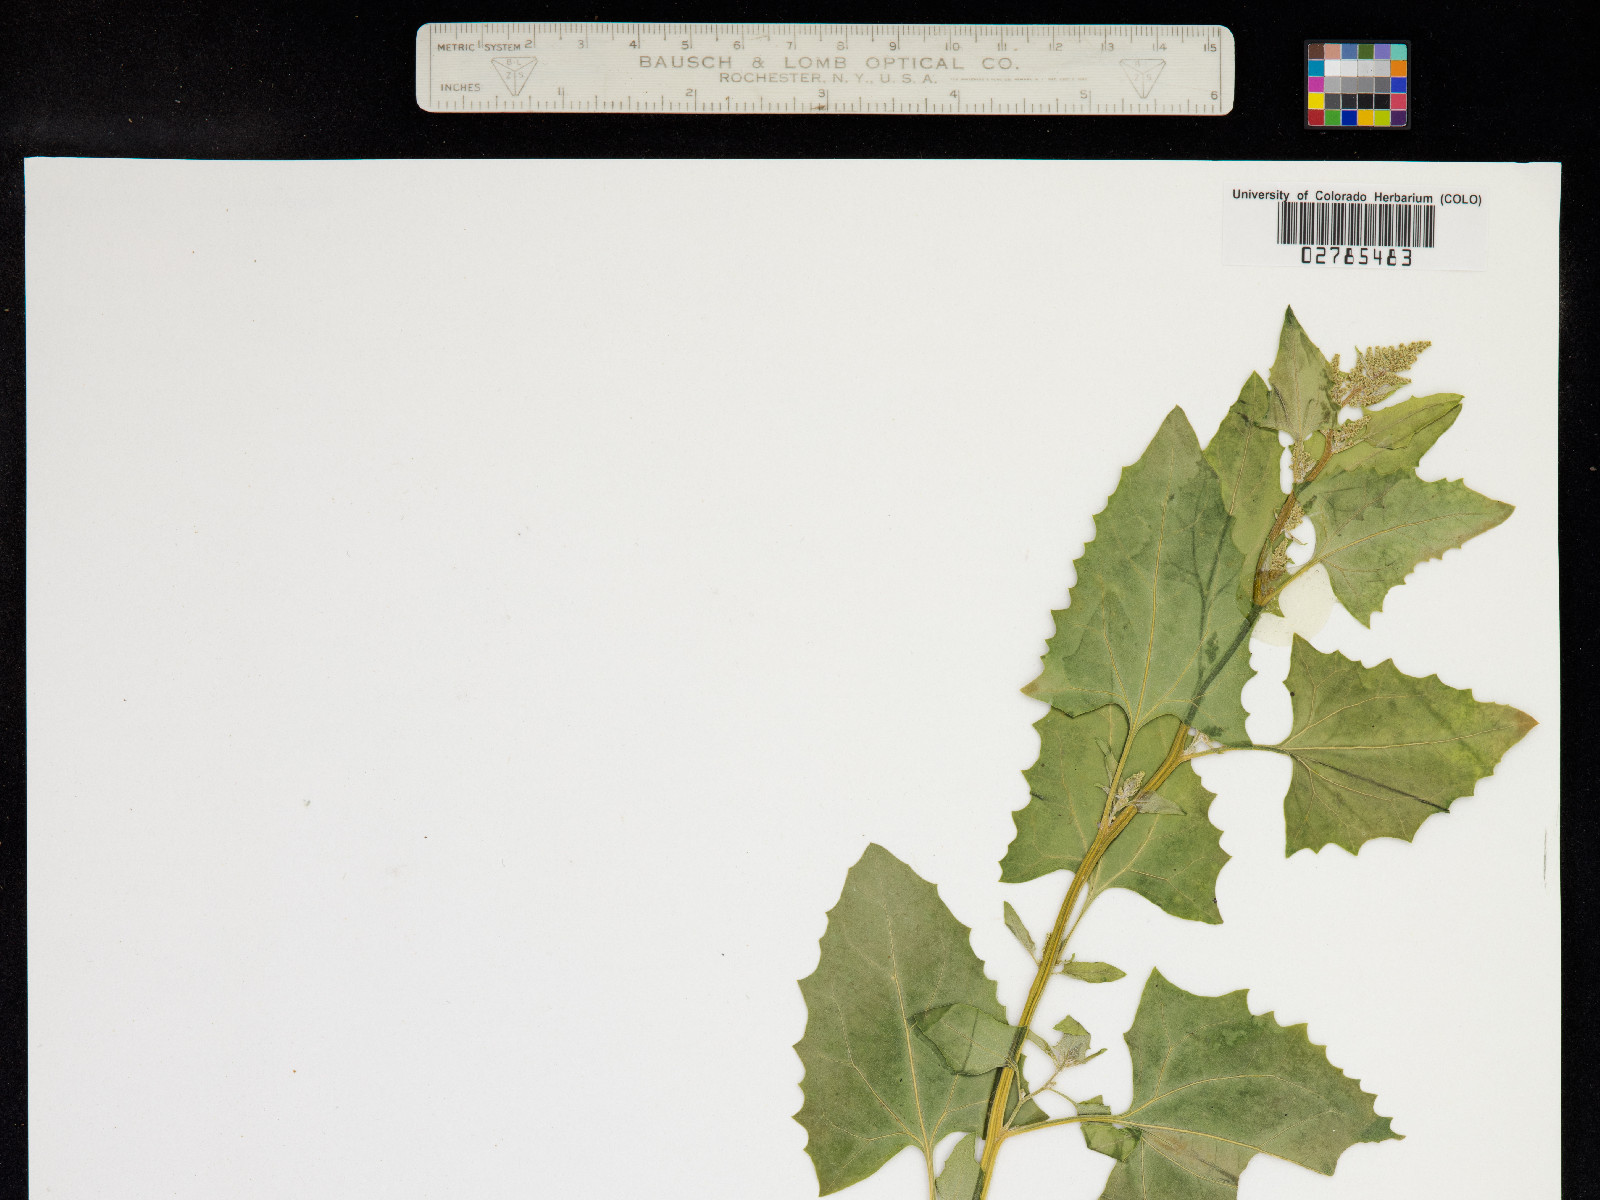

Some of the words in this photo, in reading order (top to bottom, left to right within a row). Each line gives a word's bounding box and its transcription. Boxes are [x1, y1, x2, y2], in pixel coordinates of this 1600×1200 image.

[437, 43, 475, 51] METRIC
[484, 43, 521, 51] SYSTEM
[524, 40, 533, 49] 2
[577, 40, 585, 49] 3
[629, 40, 638, 49] 4
[681, 41, 689, 50] 5
[733, 41, 741, 50] 6
[786, 41, 793, 50] 7
[837, 42, 845, 51] 8
[889, 42, 897, 51] 9
[639, 55, 733, 69] BAUSCH
[752, 56, 765, 69] &
[784, 56, 847, 69] LOMB
[865, 57, 965, 70] OPTICAL
[981, 57, 1020, 70] CO.
[719, 73, 826, 84] ROCHESTER,
[440, 83, 481, 92] INCHES
[685, 88, 694, 97] 2
[818, 89, 826, 98] 3
[949, 90, 958, 98] 4
[1211, 91, 1218, 100] 6
[1232, 189, 1290, 202] University
[1297, 191, 1308, 201] of
[1315, 190, 1367, 202] Colorado
[1374, 192, 1433, 203] Herbarium
[1440, 193, 1482, 206] (COLO)
[1301, 246, 1412, 266] 02785483
